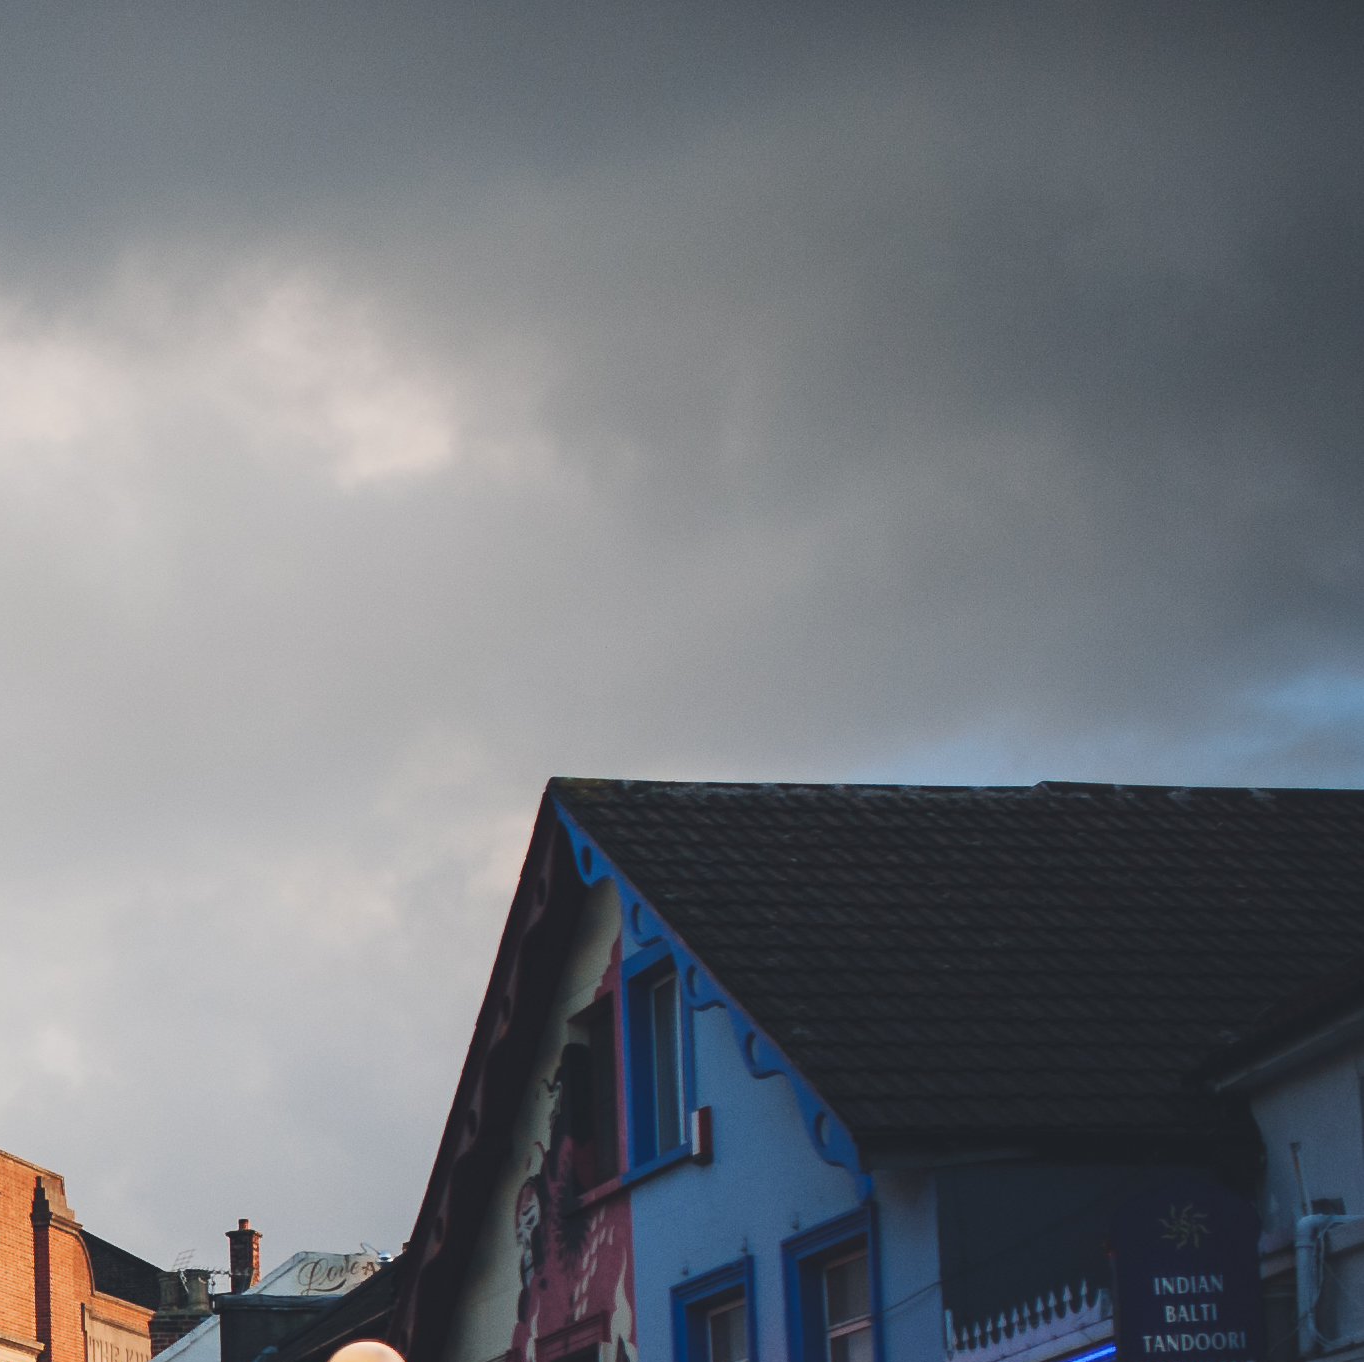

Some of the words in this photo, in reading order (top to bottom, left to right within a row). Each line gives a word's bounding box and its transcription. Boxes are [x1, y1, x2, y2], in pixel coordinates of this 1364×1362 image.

[1153, 1275, 1224, 1295] INDIAN
[1164, 1303, 1217, 1323] BALTI
[1142, 1331, 1246, 1353] TANDOORI
